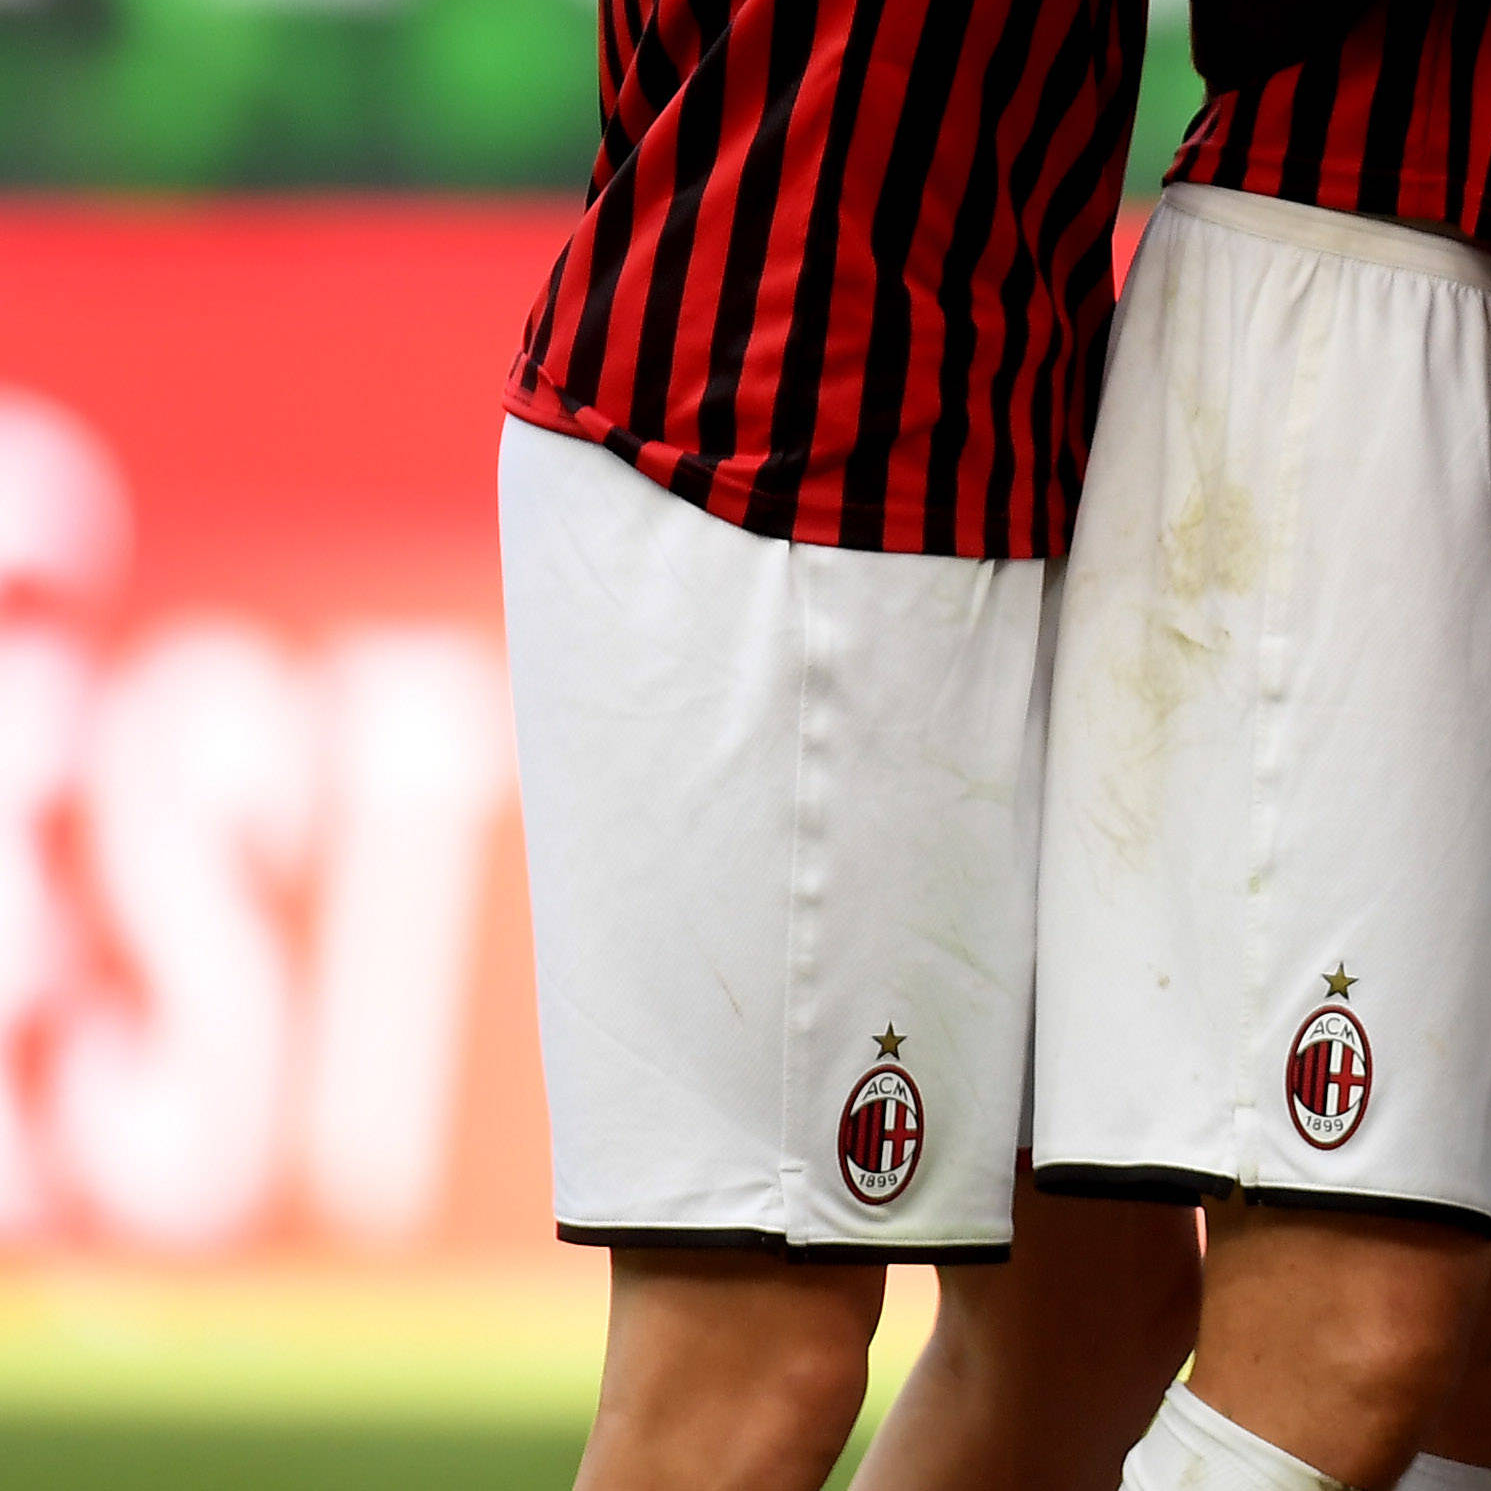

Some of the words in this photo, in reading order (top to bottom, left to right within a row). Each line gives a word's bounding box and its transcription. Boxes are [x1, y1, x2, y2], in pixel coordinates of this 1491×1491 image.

[1310, 1017, 1355, 1045] ACM
[863, 1076, 908, 1100] ACM
[1306, 1116, 1344, 1132] 1899
[859, 1173, 898, 1188] 1899
